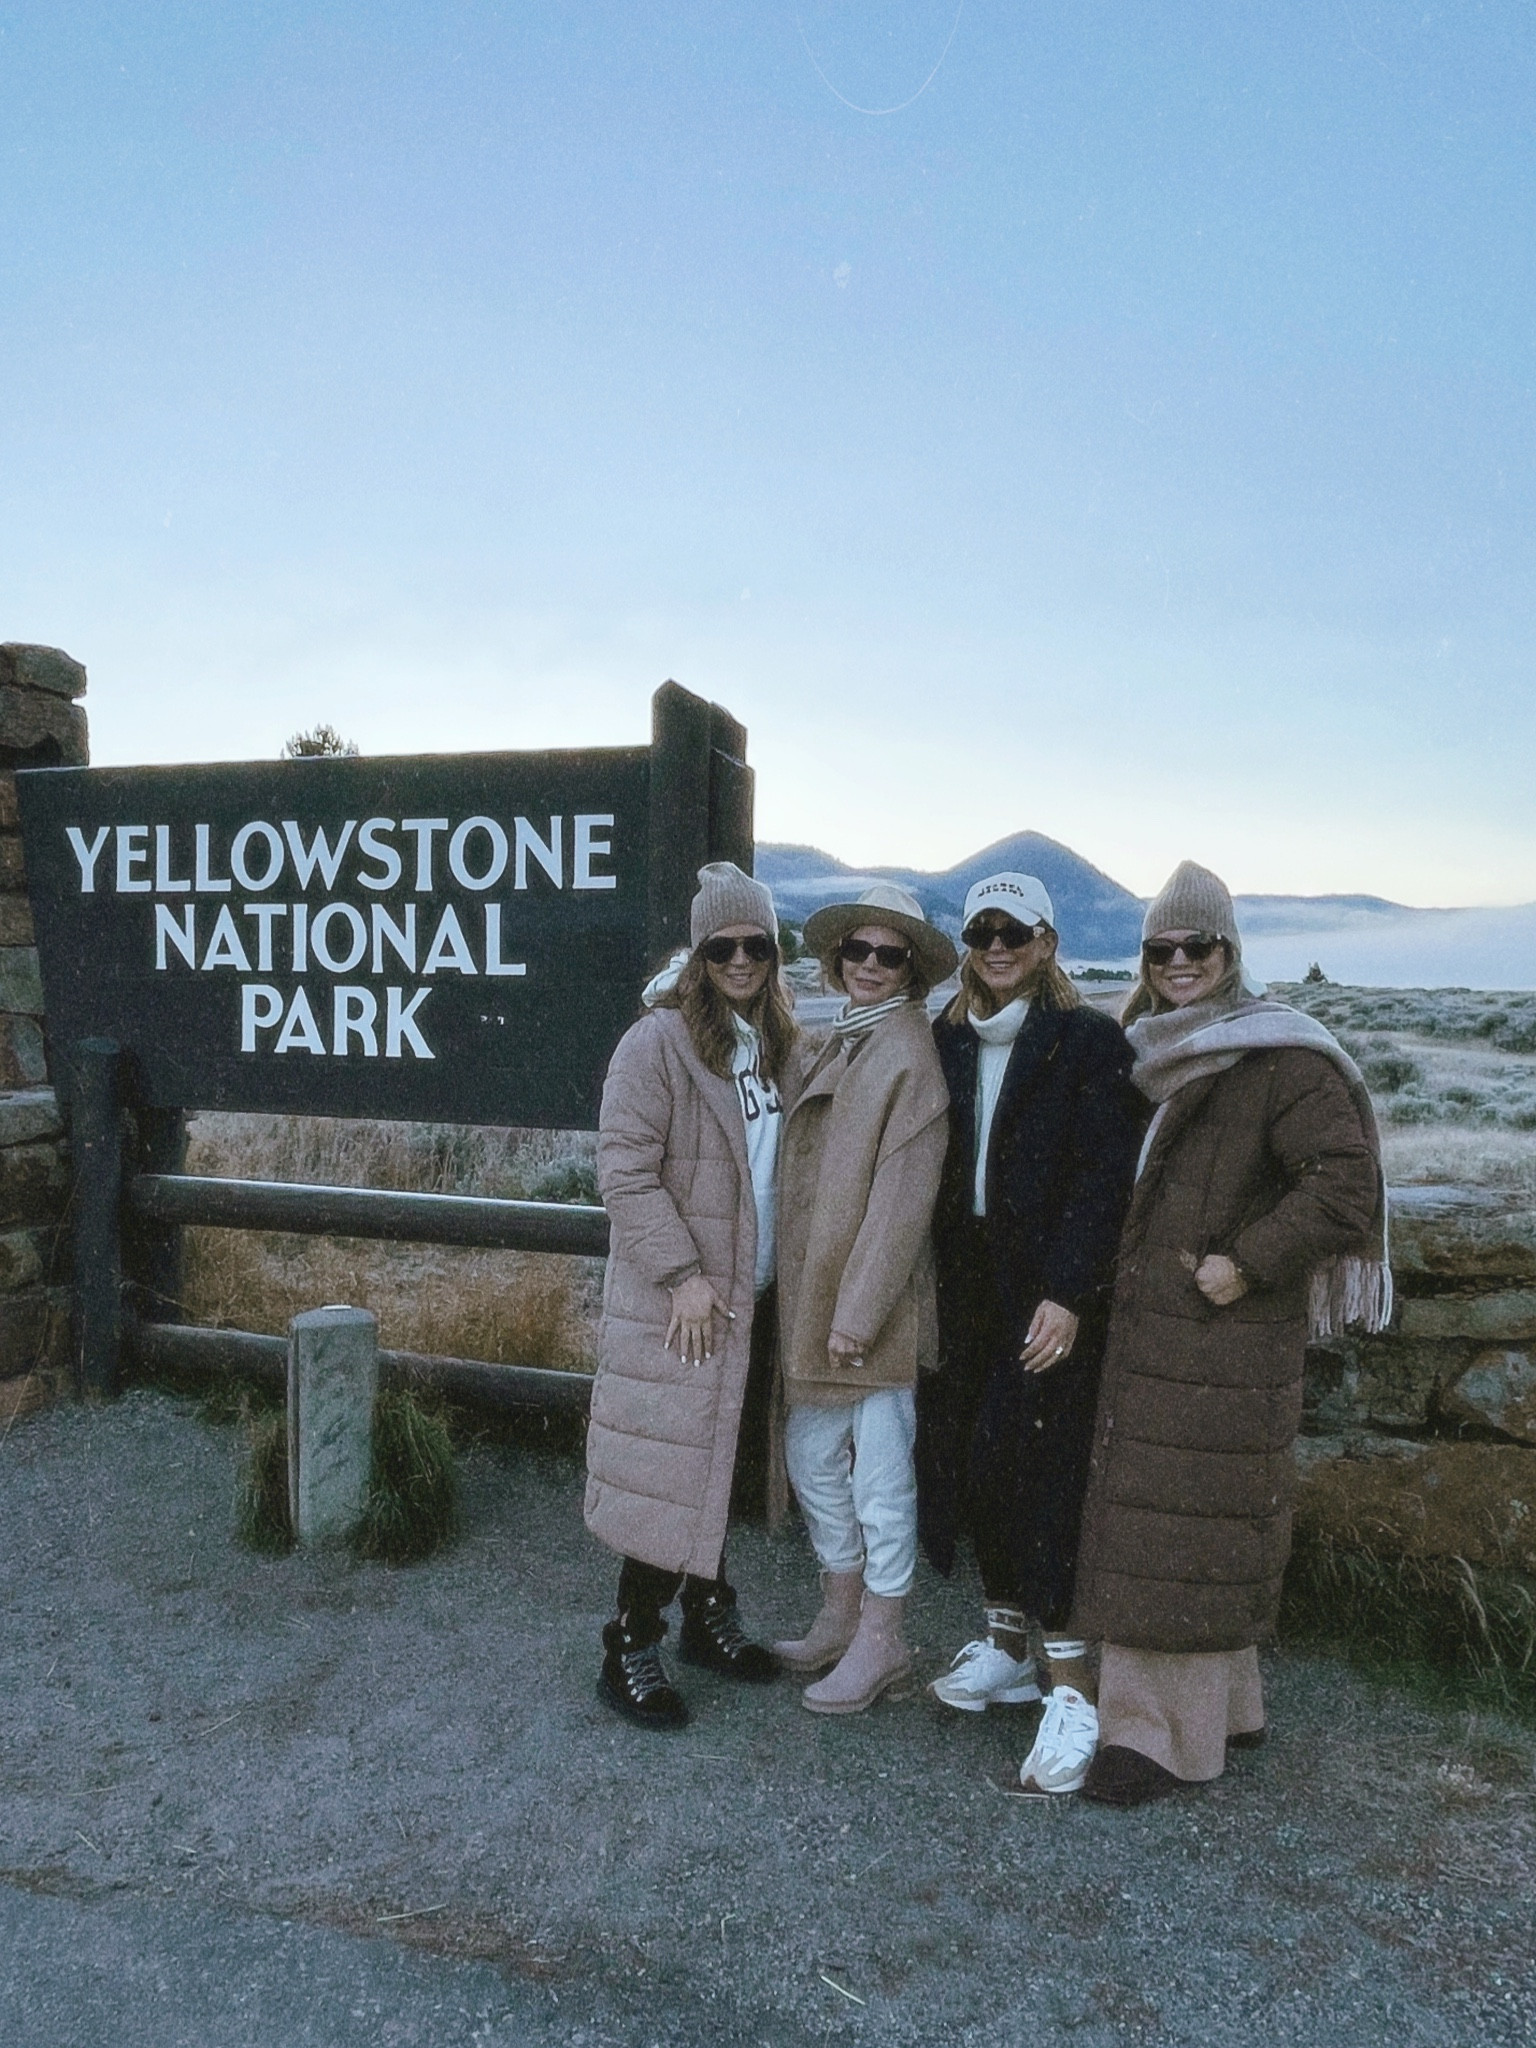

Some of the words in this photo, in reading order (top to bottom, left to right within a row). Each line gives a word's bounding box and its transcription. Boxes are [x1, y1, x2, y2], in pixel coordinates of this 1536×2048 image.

[65, 813, 617, 893] YELLOWSTONE
[154, 902, 527, 977] NATIONAL
[240, 984, 436, 1059] PARK
